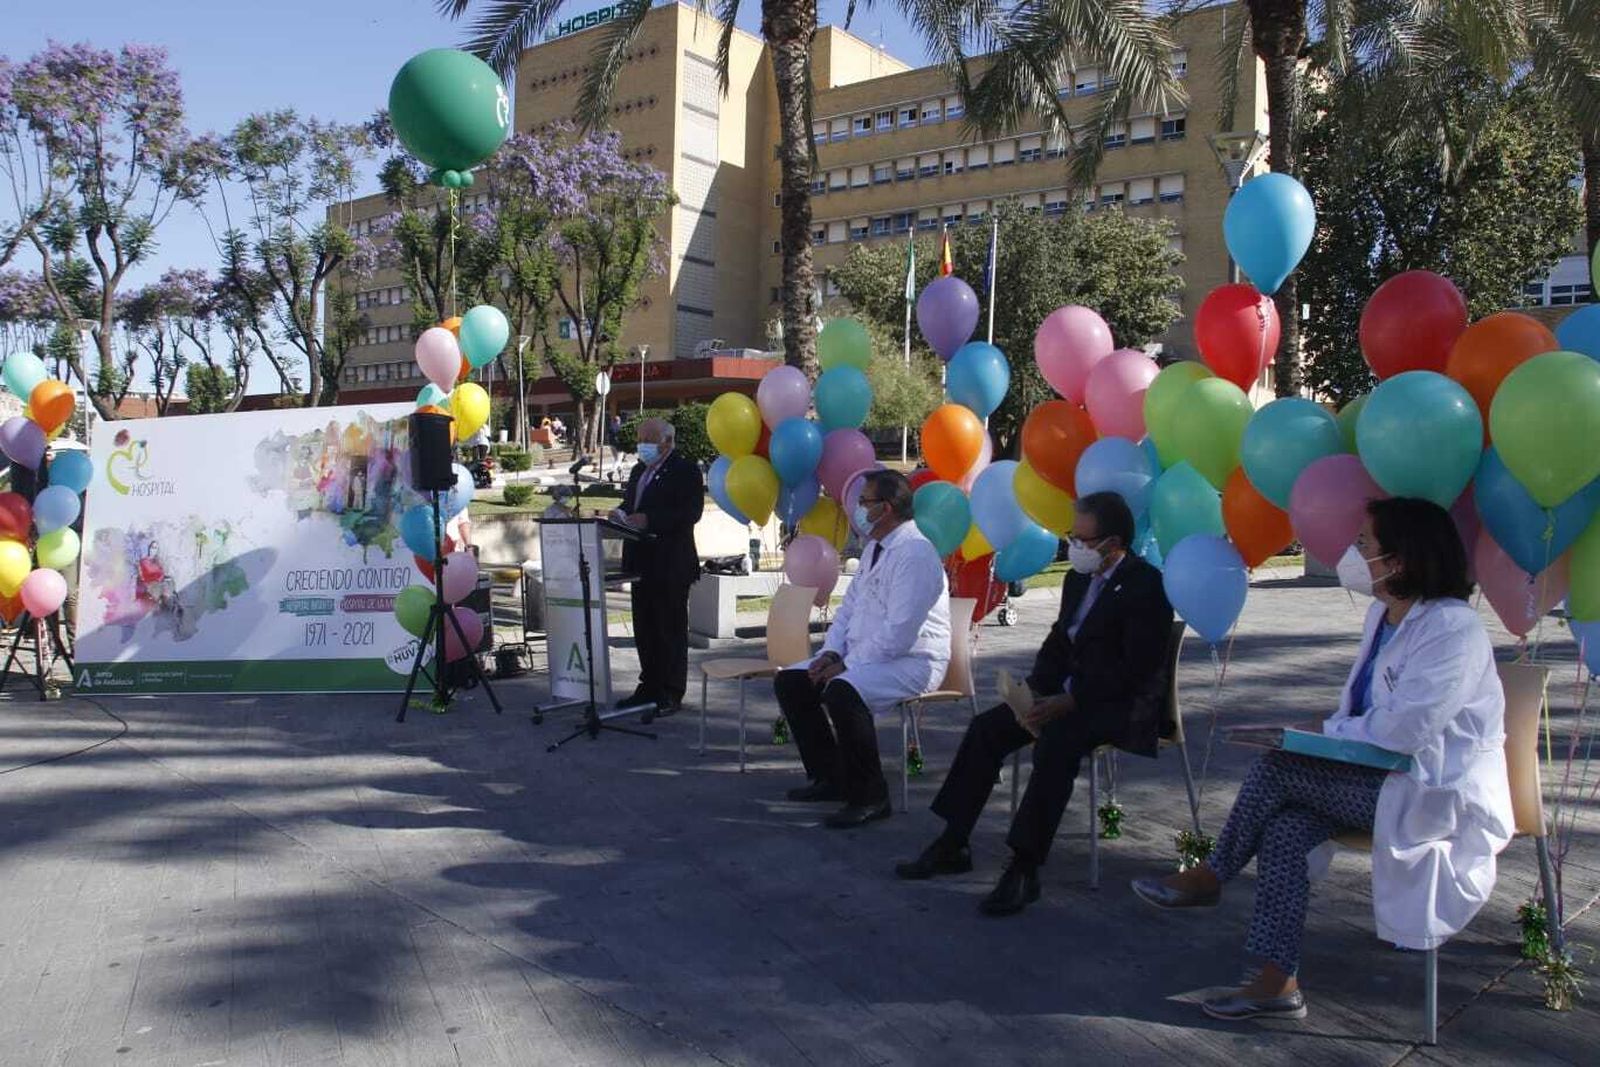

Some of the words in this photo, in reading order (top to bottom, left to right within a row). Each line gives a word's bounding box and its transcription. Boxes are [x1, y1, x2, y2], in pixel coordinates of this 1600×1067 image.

[559, 2, 642, 36] HOSPIT
[131, 481, 177, 496] HOSPITAL
[286, 568, 353, 592] CRECIENDO
[357, 566, 411, 589] CONTIGO
[305, 622, 326, 647] 1971
[343, 621, 375, 646] 2021
[393, 647, 415, 664] HUV
